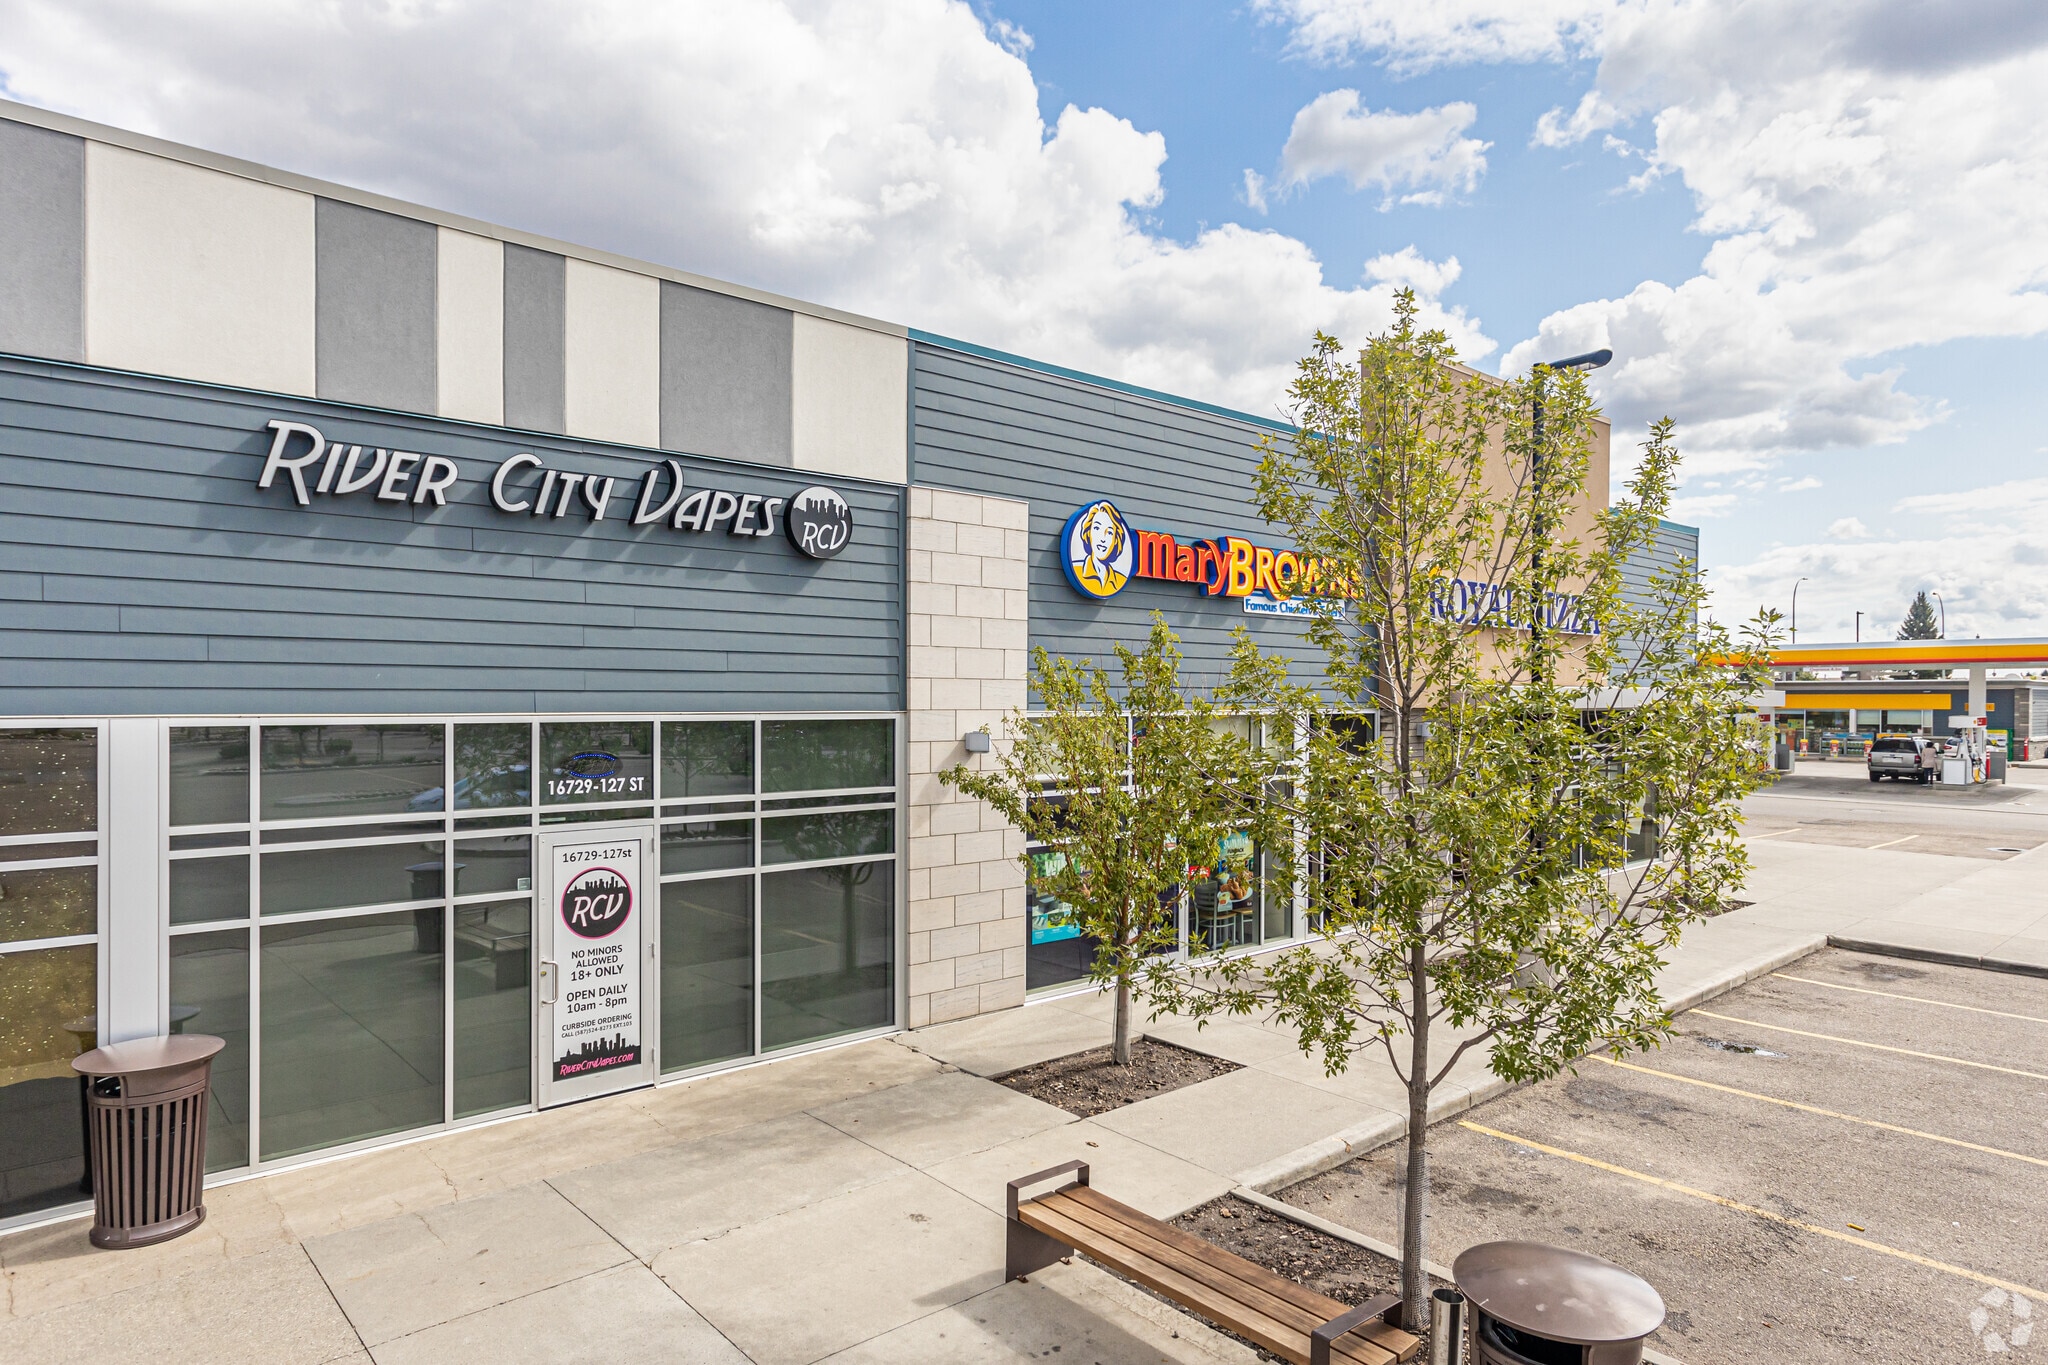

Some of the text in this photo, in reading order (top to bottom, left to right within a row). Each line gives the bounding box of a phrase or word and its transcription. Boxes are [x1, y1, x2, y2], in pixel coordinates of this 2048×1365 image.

[256, 418, 783, 537] RIVER CITY VAPES
[802, 519, 848, 554] RCV
[1245, 599, 1278, 612] Famous
[1527, 587, 1601, 636] IZZA
[548, 776, 645, 796] 16729-127 ST
[562, 848, 632, 863] 16729-127st
[571, 893, 624, 927] RCV
[571, 944, 623, 960] NO MINORS
[576, 954, 619, 969] ALLOWED
[570, 964, 625, 982] 18+ ONLY
[566, 983, 628, 1002] OPEN DAILY
[567, 1002, 596, 1014] 10am
[605, 997, 627, 1009] 8pm
[561, 1012, 633, 1032] CURBSIDE ORDERING
[561, 1031, 574, 1039] CALL
